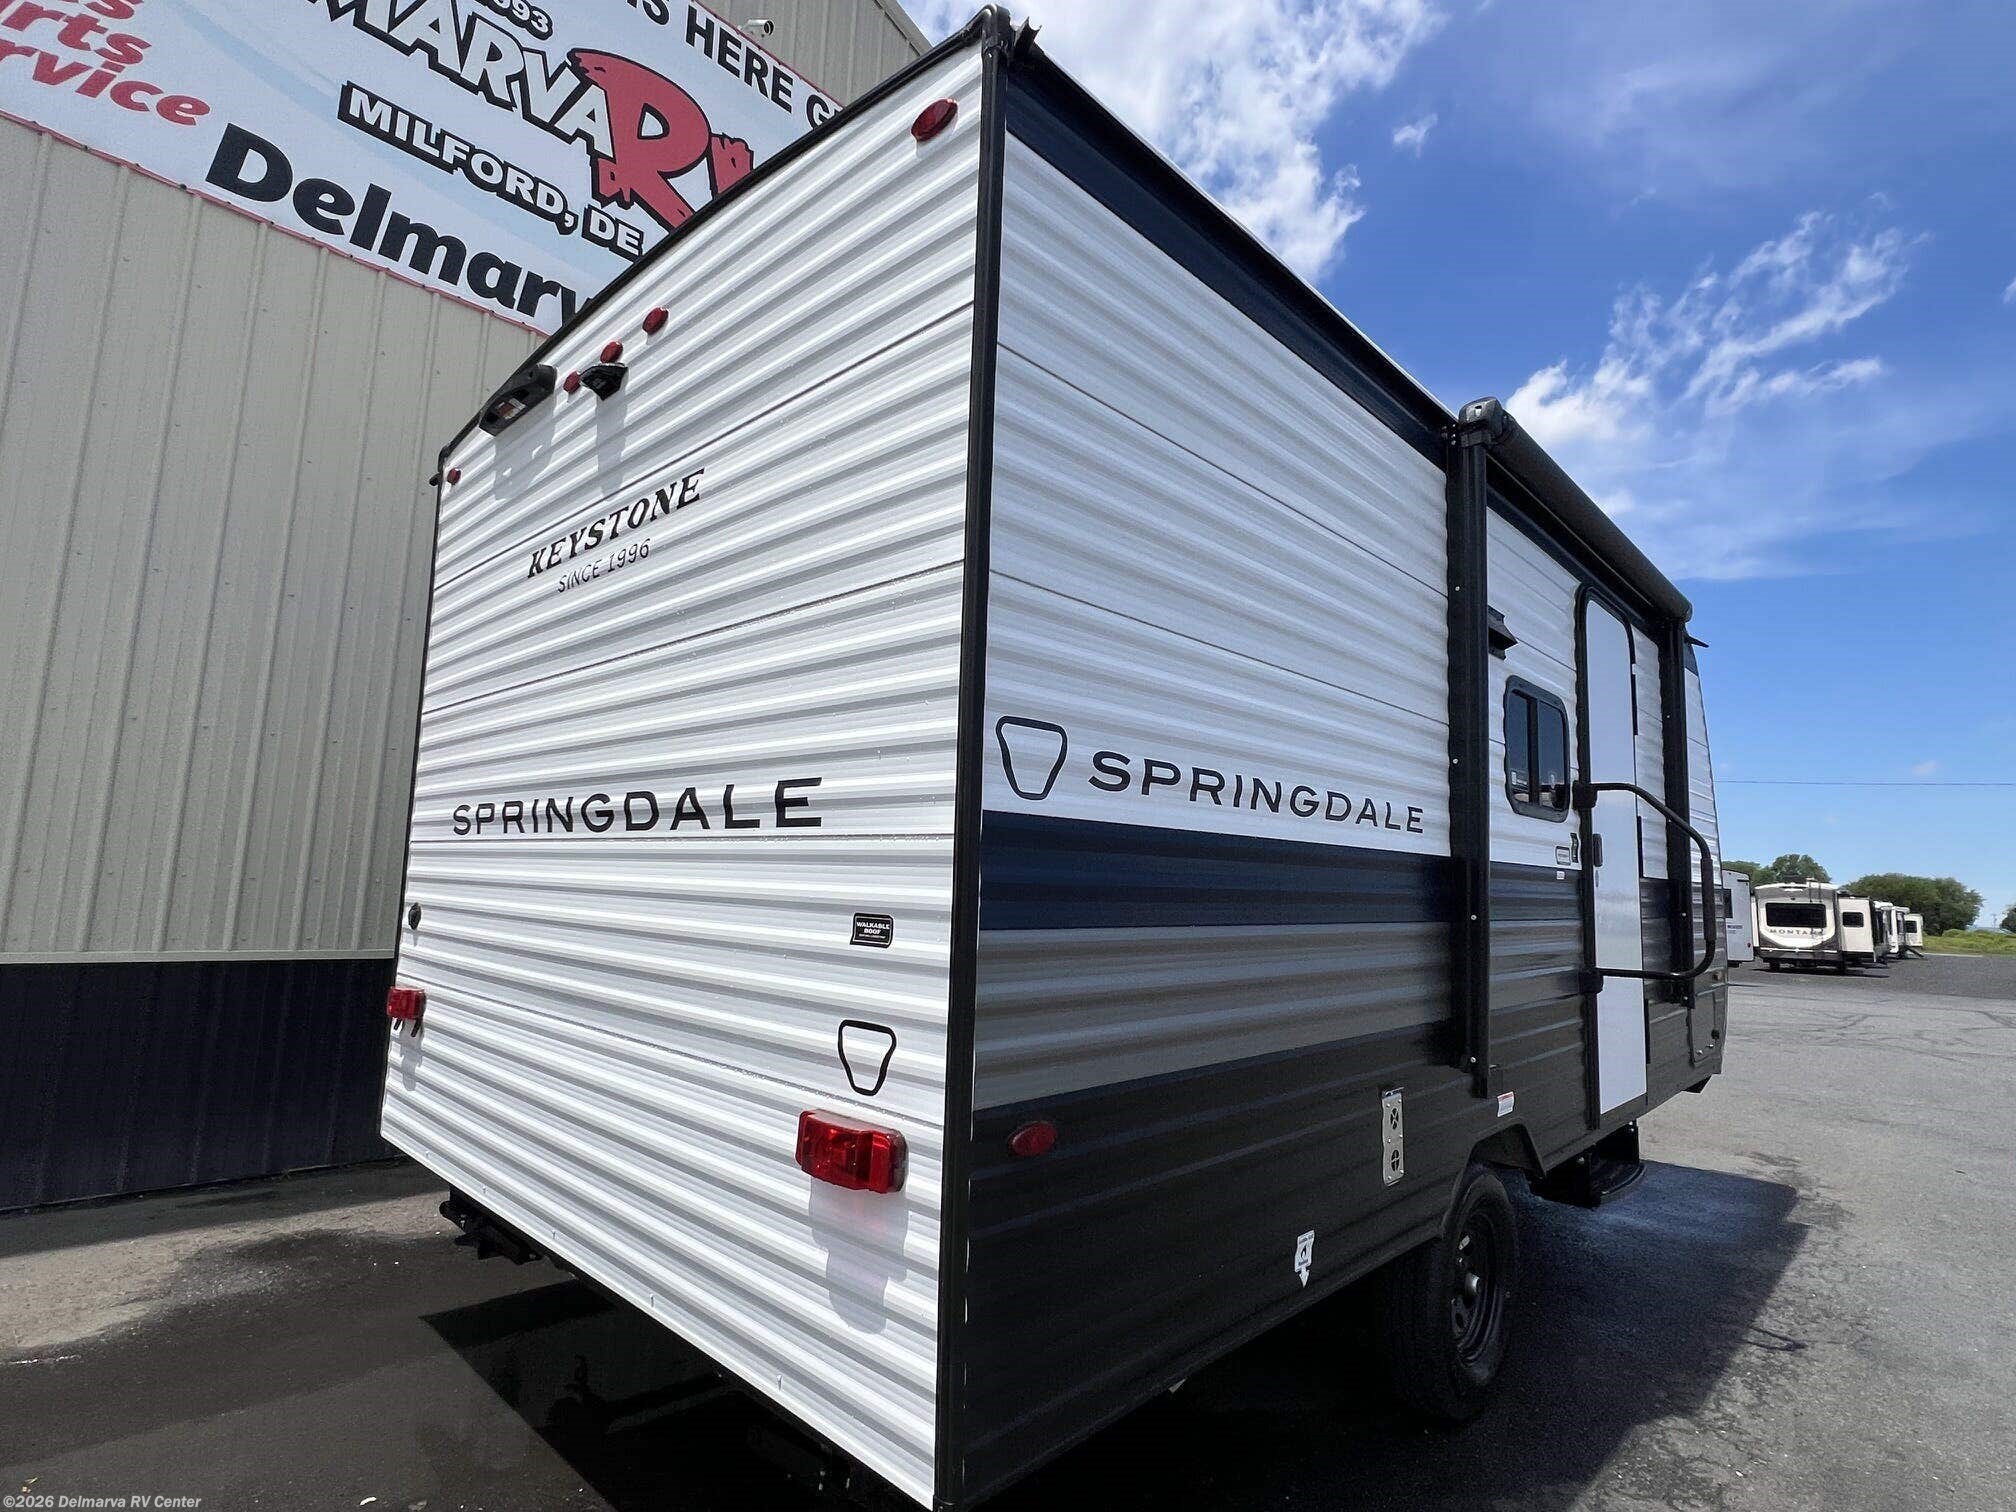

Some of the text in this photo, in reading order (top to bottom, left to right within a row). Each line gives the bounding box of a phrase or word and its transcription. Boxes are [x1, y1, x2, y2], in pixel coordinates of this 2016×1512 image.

[0, 0, 151, 65] rts
[685, 5, 793, 114] HERE
[806, 94, 845, 131] G
[343, 84, 643, 258] MILFORD, DE
[527, 468, 705, 578] KEYSTONE
[557, 538, 651, 593] SINCE 1996
[453, 776, 823, 836] SPRINGDALE
[1088, 750, 1424, 834] SPRINGDALE
[856, 921, 891, 930] WALKABLE
